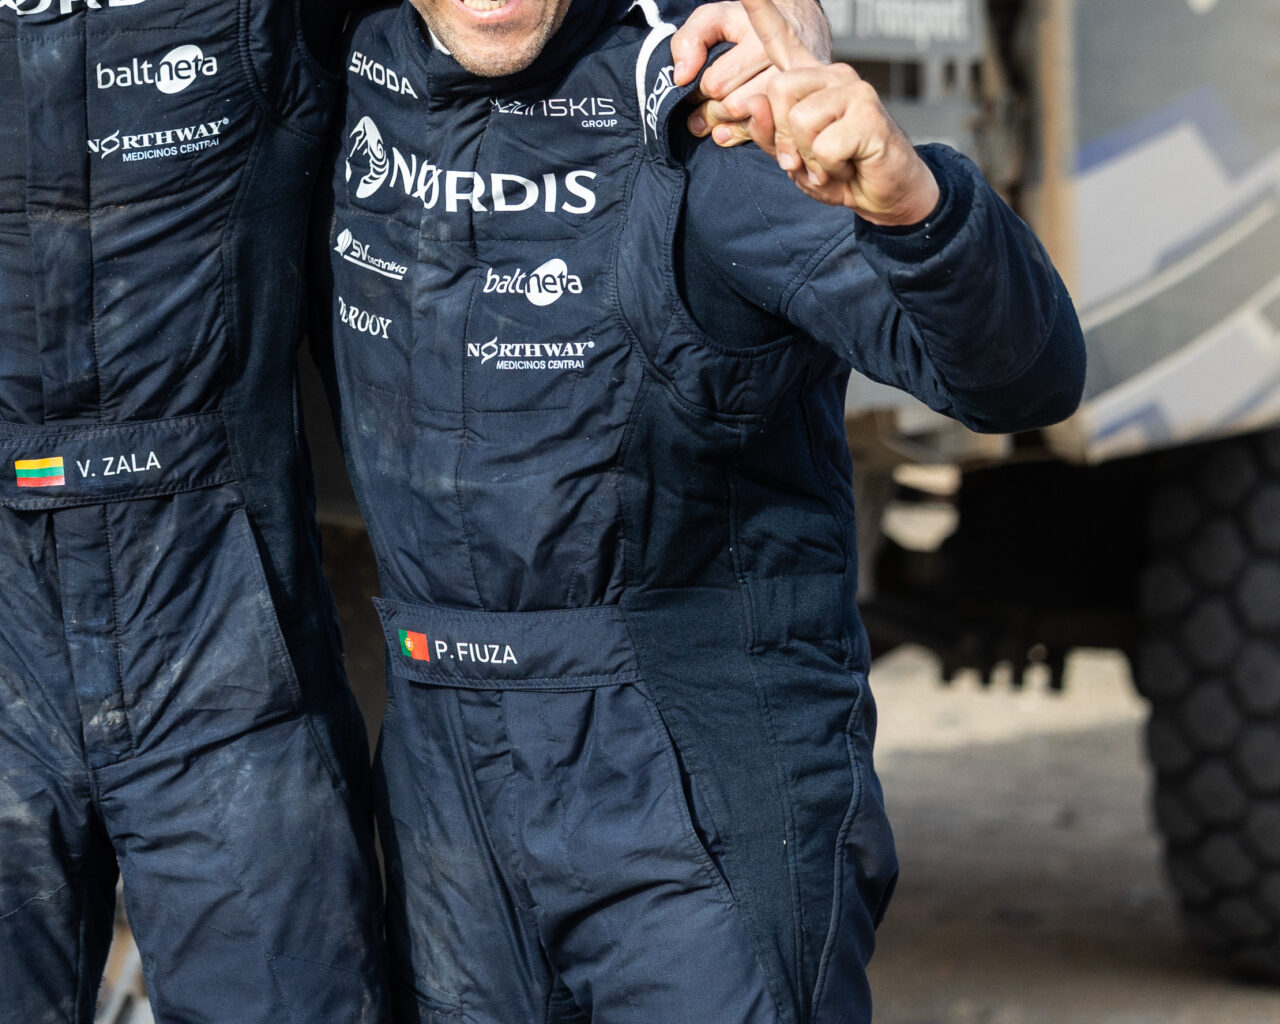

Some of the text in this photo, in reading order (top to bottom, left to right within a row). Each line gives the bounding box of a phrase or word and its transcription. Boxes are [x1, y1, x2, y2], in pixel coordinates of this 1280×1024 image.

[96, 54, 219, 90] baltneta
[581, 119, 618, 128] GROUP
[122, 147, 178, 163] MEDICINOS
[483, 265, 583, 296] baltneta
[348, 305, 393, 339] ROOY
[496, 360, 546, 370] MEDICINOS
[76, 451, 162, 478] V. ZALA
